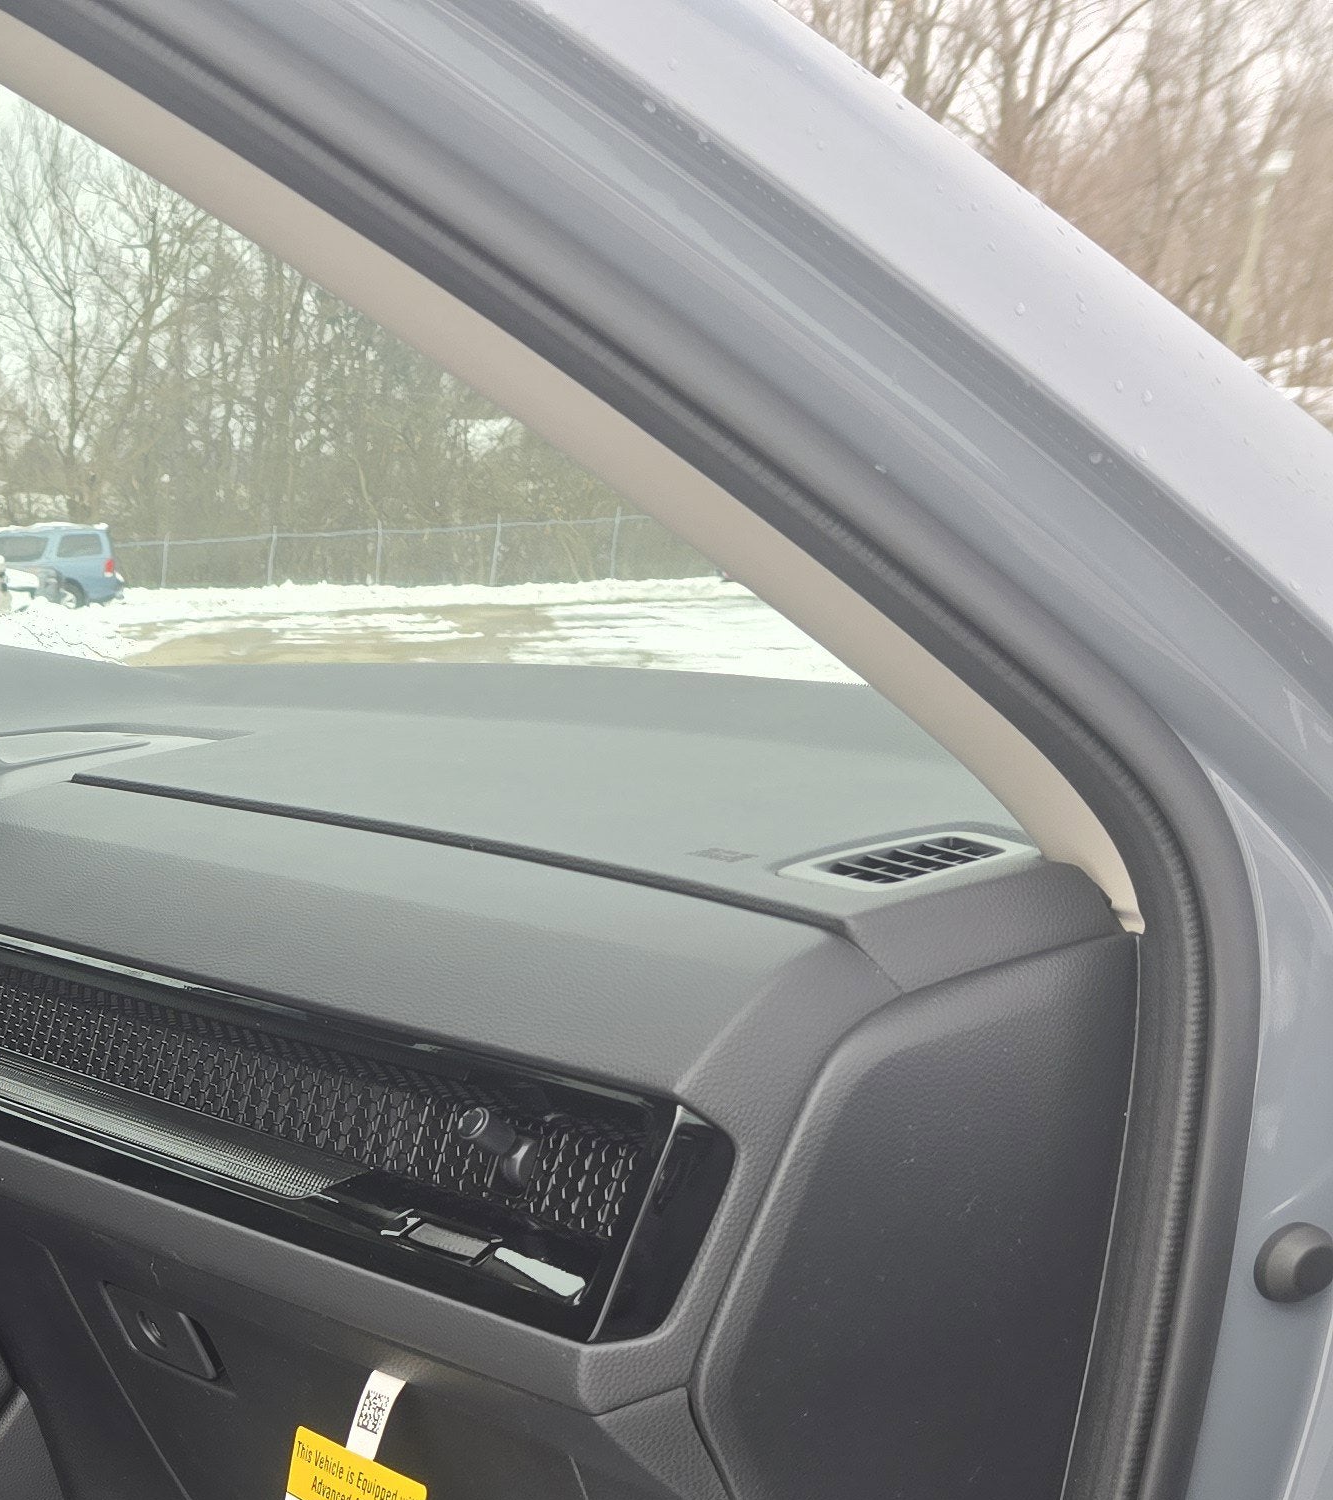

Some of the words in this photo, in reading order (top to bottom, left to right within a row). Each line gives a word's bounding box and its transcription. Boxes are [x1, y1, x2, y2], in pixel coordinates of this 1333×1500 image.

[297, 1441, 312, 1463] This
[314, 1450, 343, 1479] Vehicle
[346, 1466, 354, 1484] is
